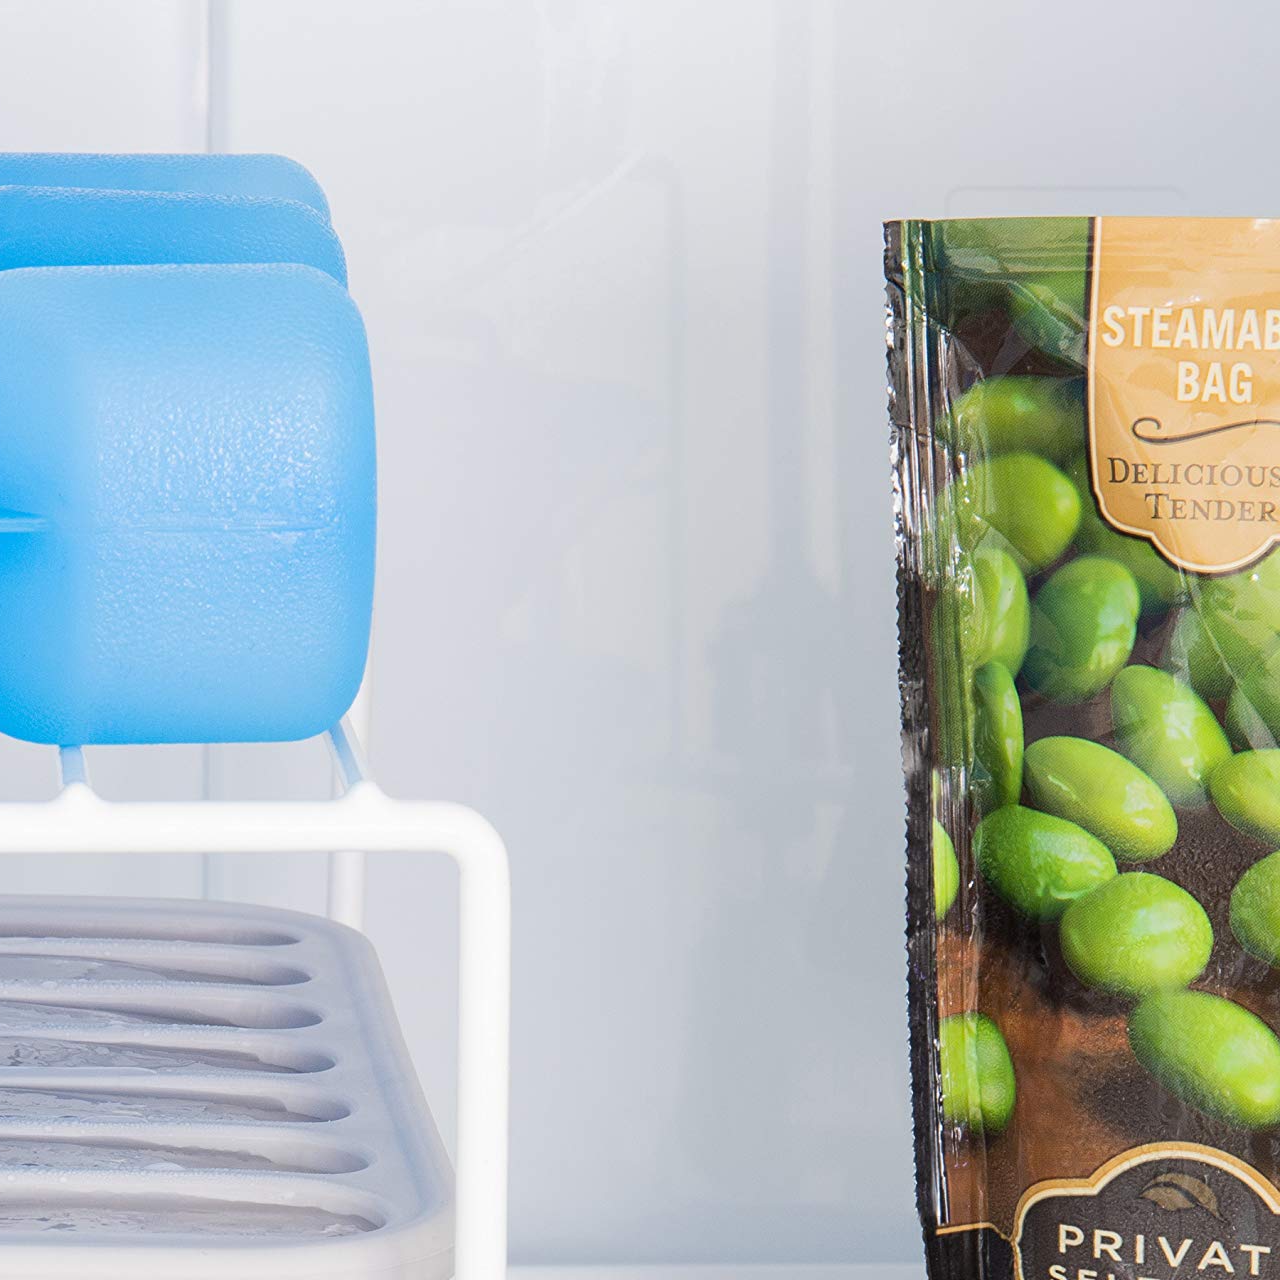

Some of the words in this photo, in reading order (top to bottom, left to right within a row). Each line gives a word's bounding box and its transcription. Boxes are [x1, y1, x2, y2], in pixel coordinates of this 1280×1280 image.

[1102, 305, 1280, 350] STEAMAB
[1177, 361, 1253, 404] BAG
[1107, 457, 1280, 488] DELICIOUS
[1145, 493, 1278, 522] TENDER
[1058, 1223, 1271, 1276] PRIVAT
